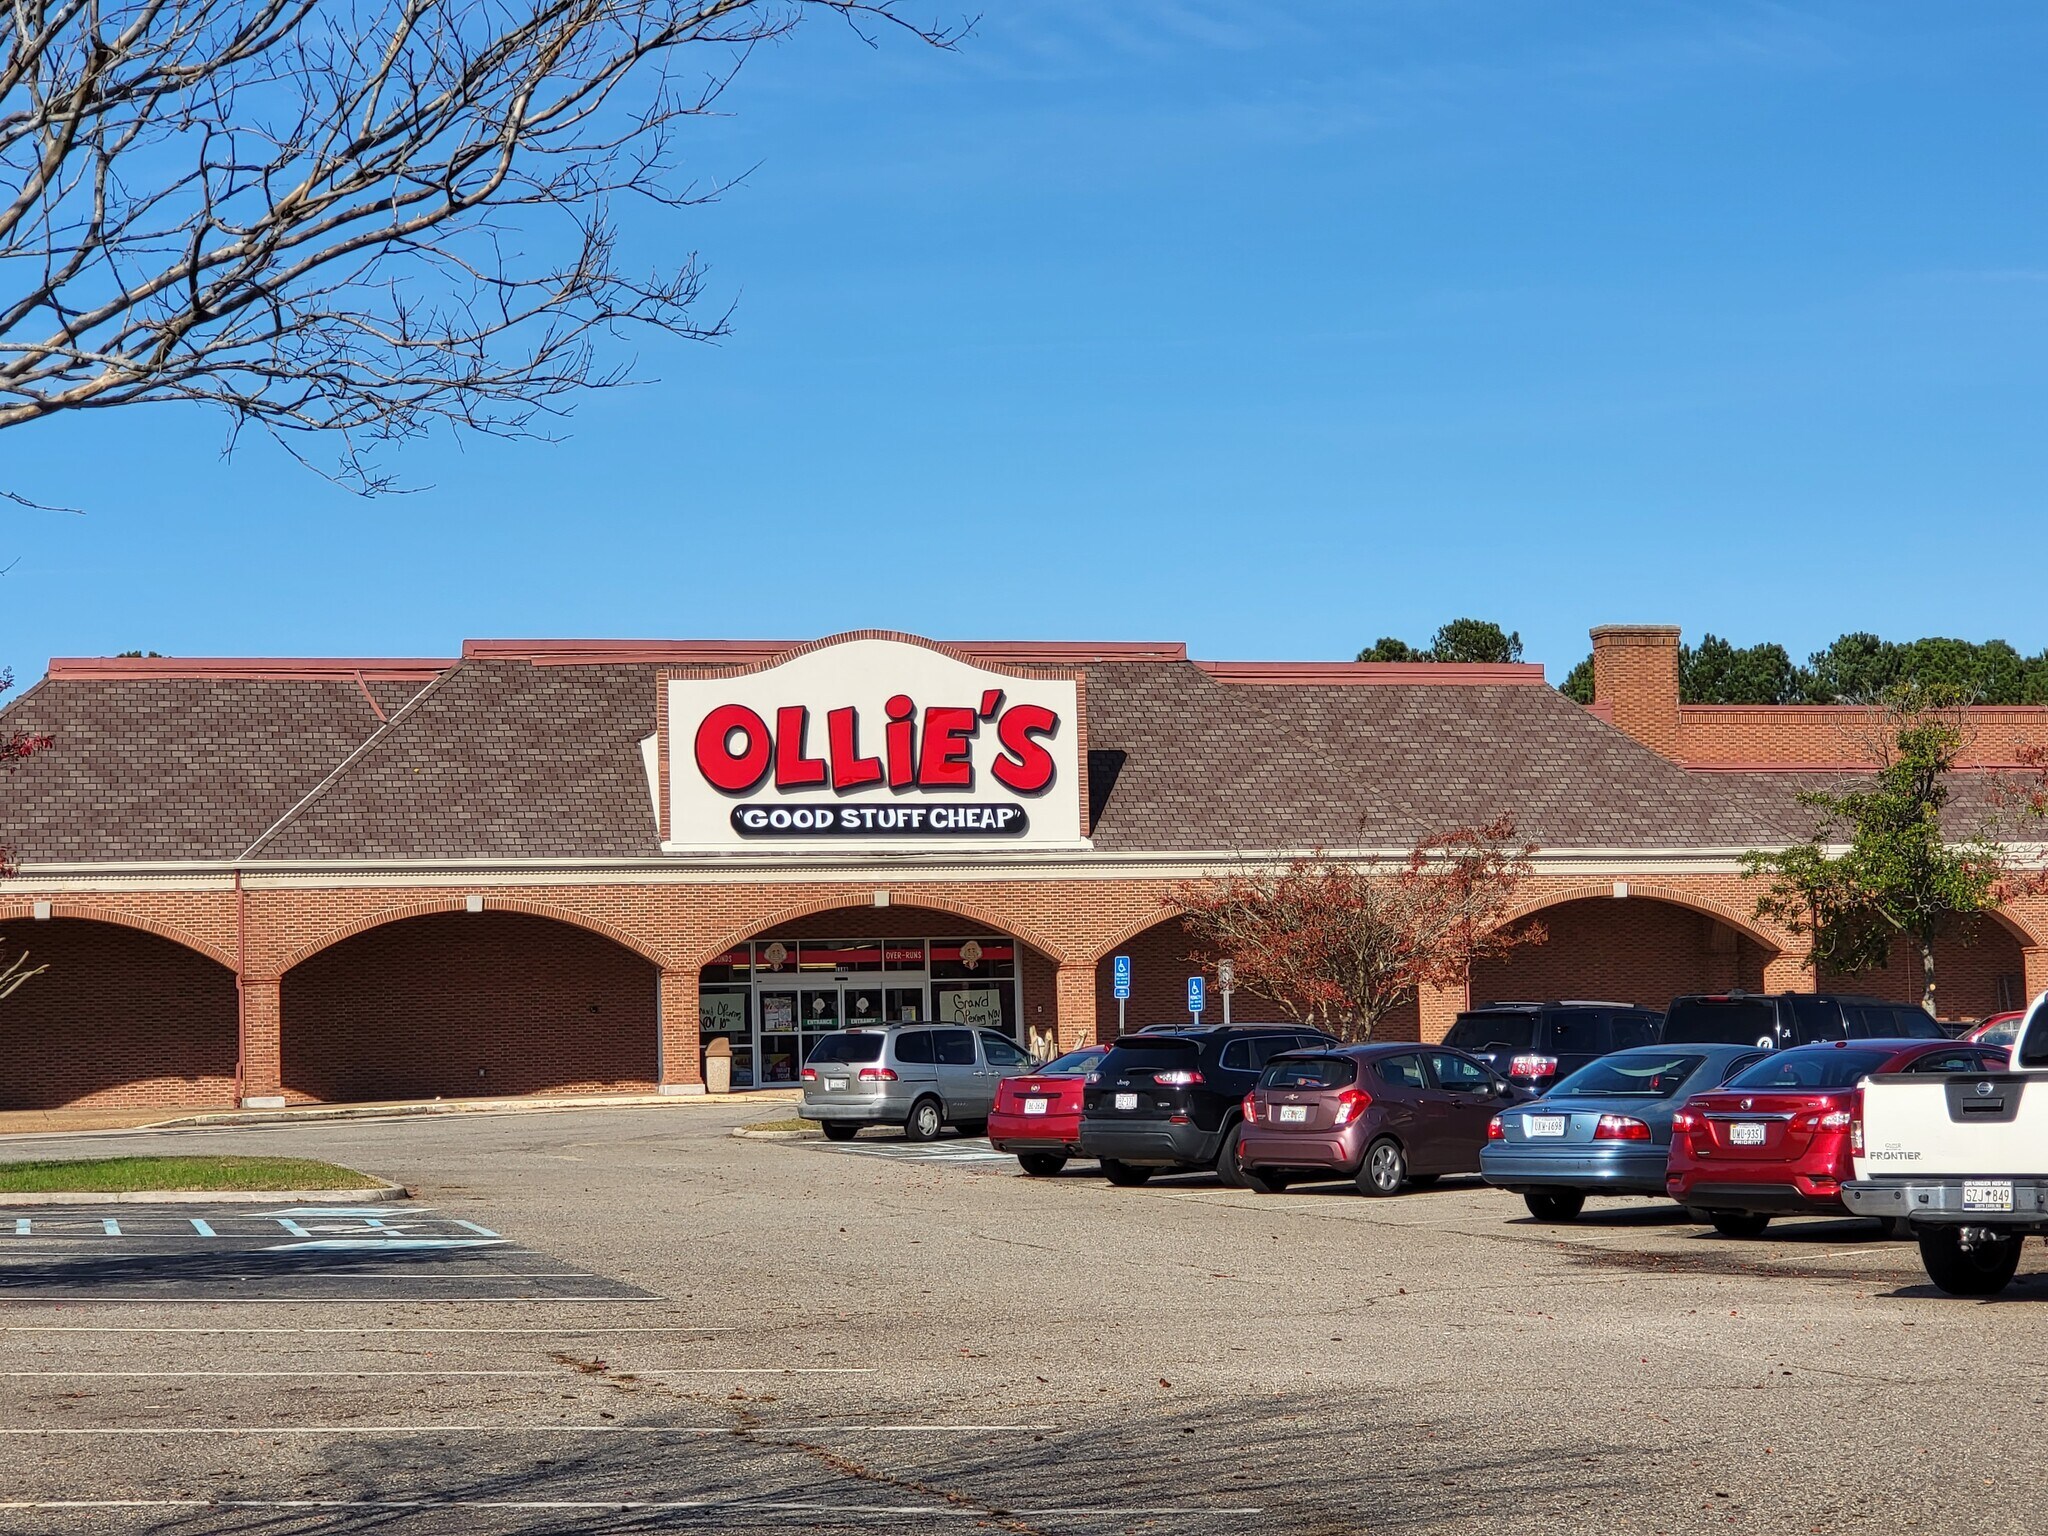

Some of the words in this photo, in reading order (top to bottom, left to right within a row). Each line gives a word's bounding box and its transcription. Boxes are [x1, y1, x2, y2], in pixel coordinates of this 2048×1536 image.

[840, 808, 928, 829] STUFF
[885, 951, 922, 960] OVER-RUNS
[953, 991, 989, 1010] Grand
[850, 1017, 876, 1025] ENTRANCE
[1116, 1079, 1131, 1087] Jeep
[1869, 1151, 1923, 1161] FRONTIER
[1992, 1188, 2010, 1202] 849
